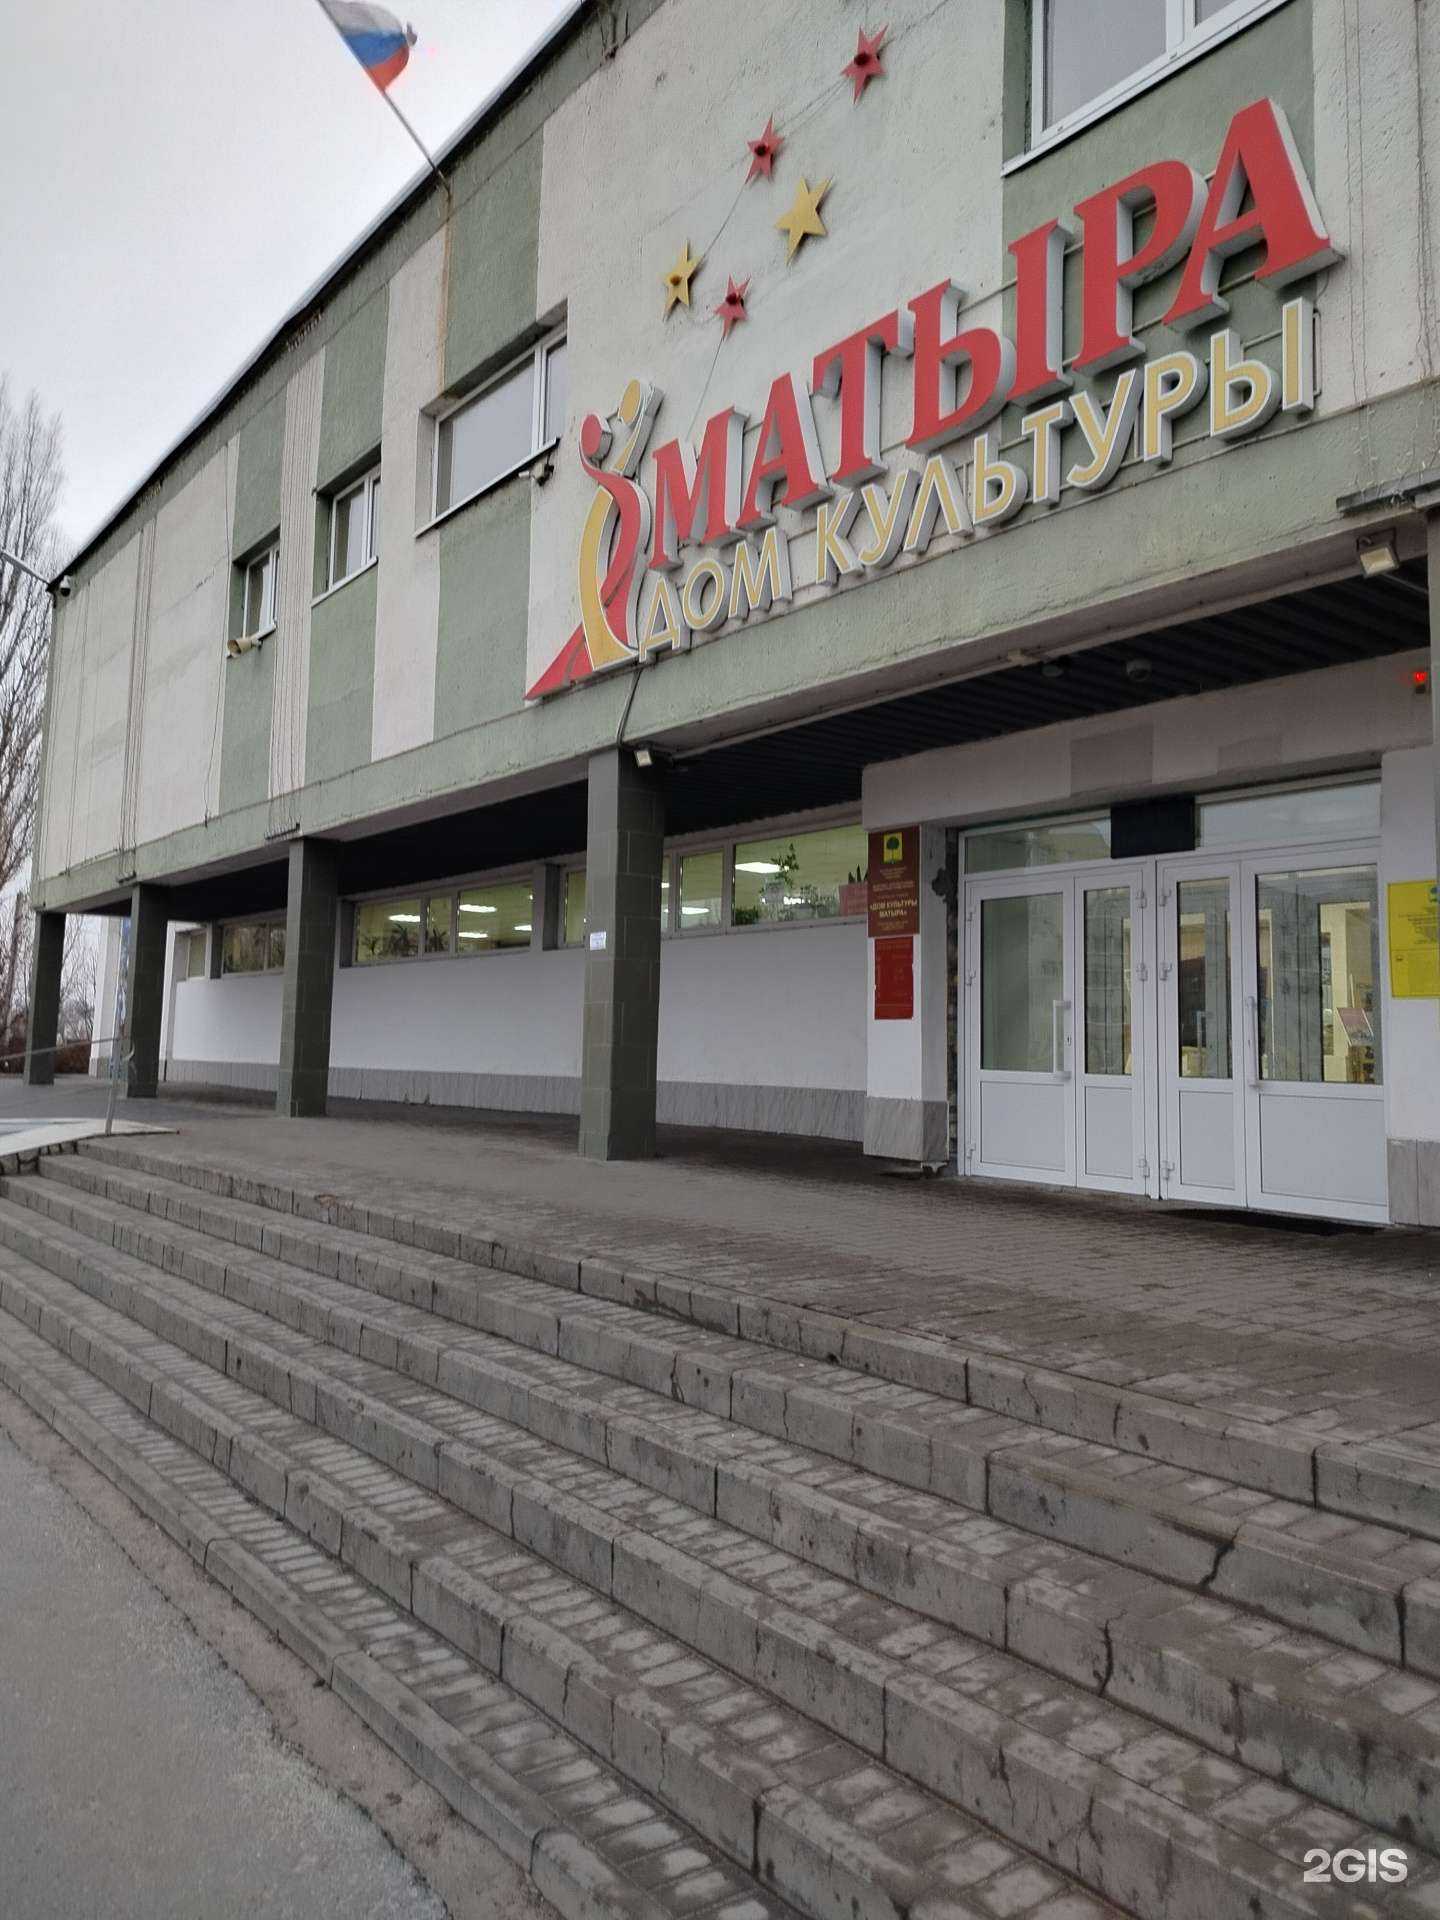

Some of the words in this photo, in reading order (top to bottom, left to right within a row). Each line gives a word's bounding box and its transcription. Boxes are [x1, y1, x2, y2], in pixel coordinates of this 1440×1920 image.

[638, 527, 792, 663] ДОМ
[815, 296, 1315, 585] КУЛЬТУРЫ
[650, 98, 1340, 571] МАТЫРА
